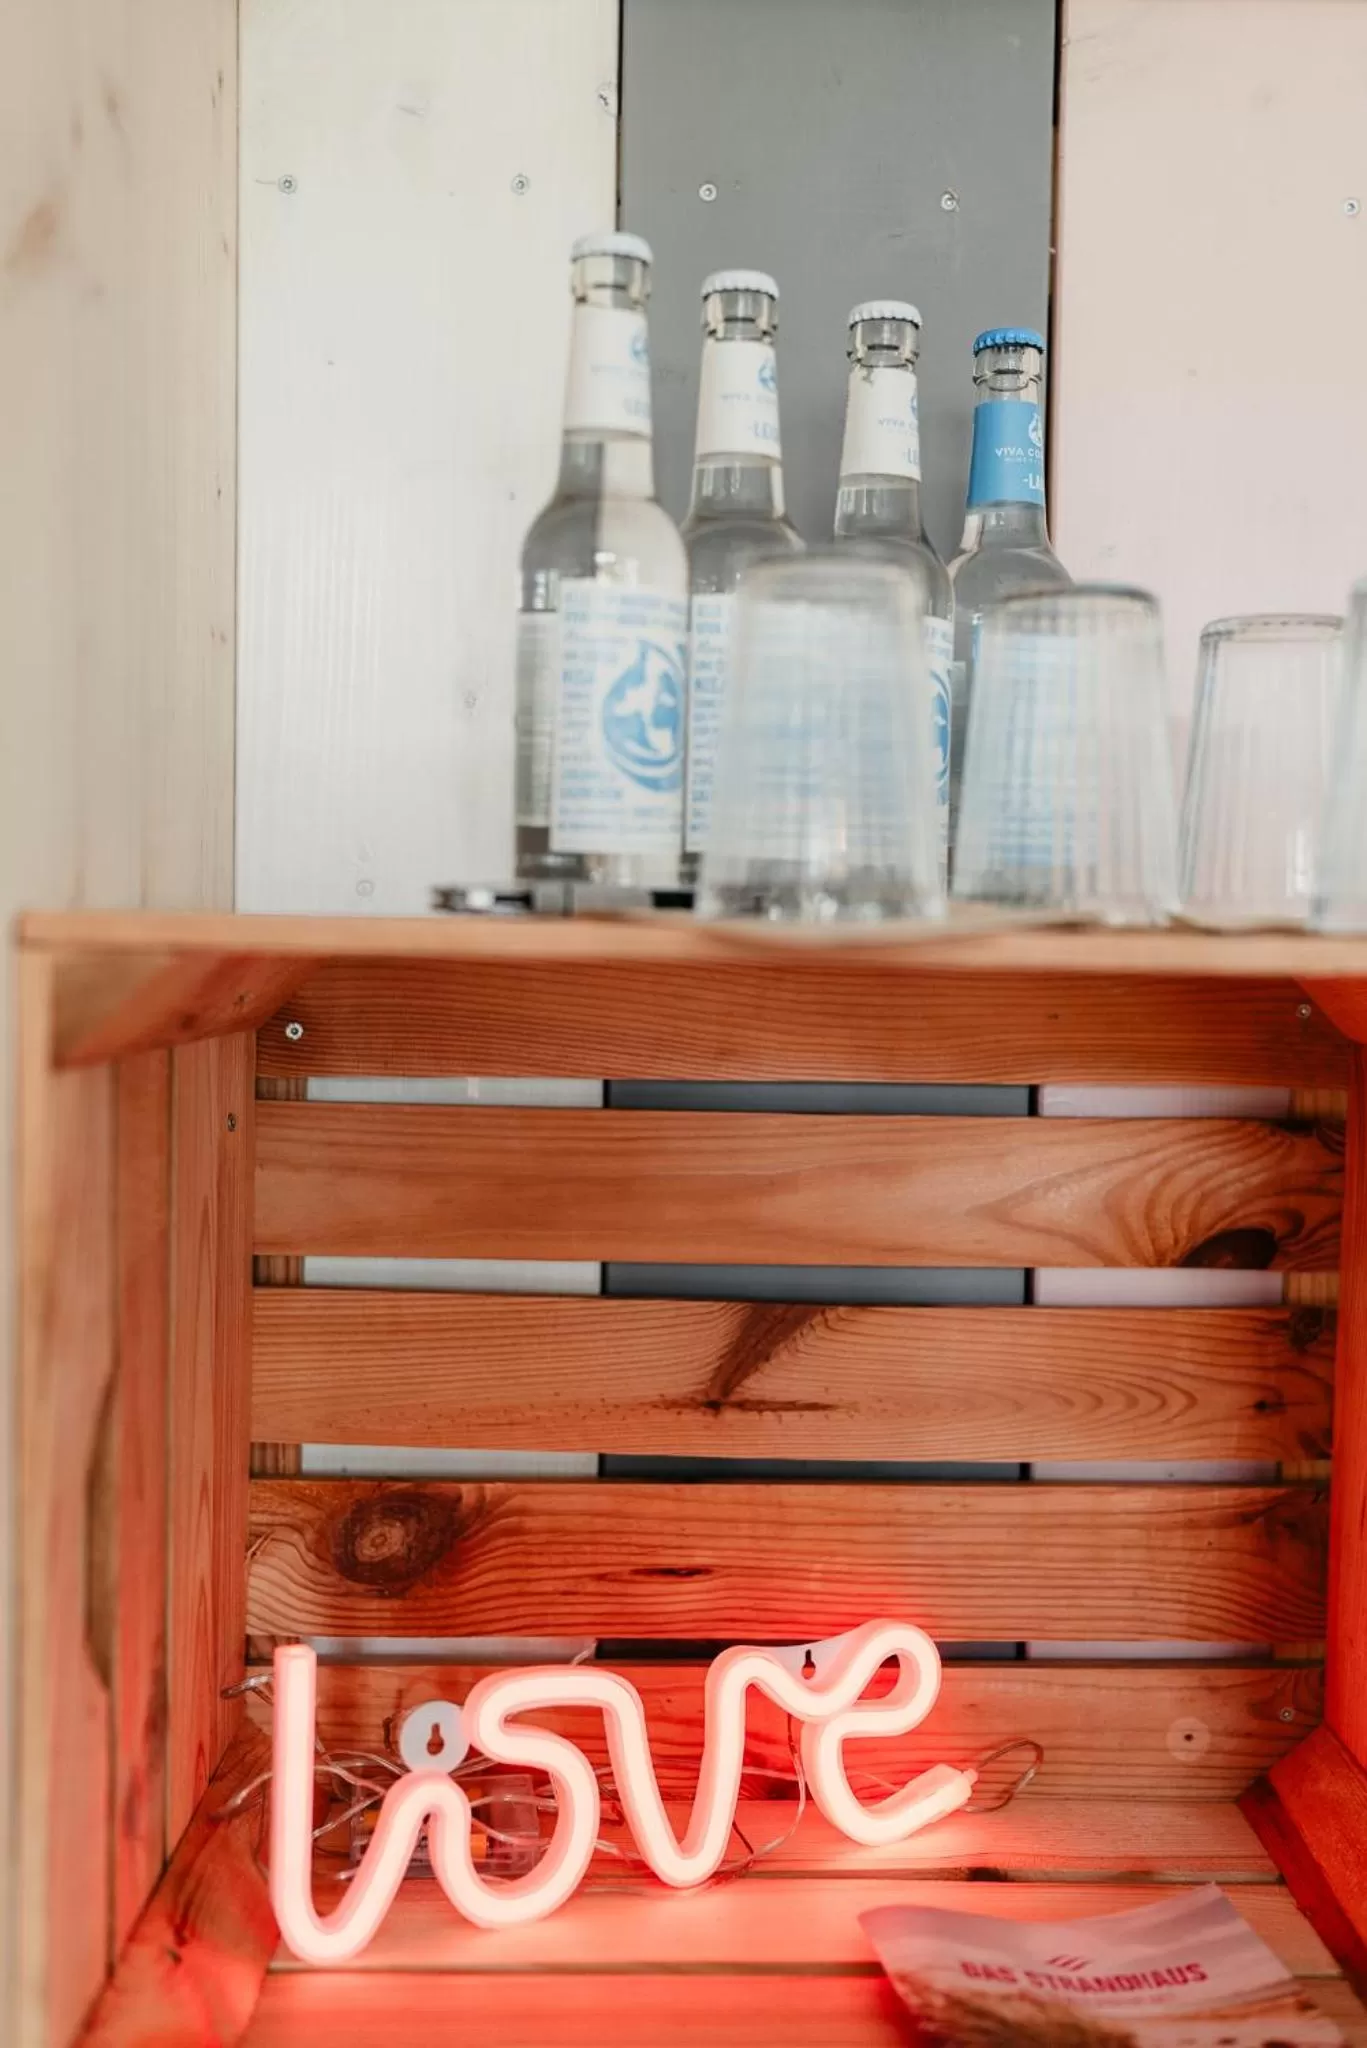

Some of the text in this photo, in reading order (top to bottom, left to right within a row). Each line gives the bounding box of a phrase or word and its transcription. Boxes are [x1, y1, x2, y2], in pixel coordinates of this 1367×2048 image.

[995, 446, 1024, 457] VIVA
[960, 1959, 1209, 1994] DAS STRANDHAUS
